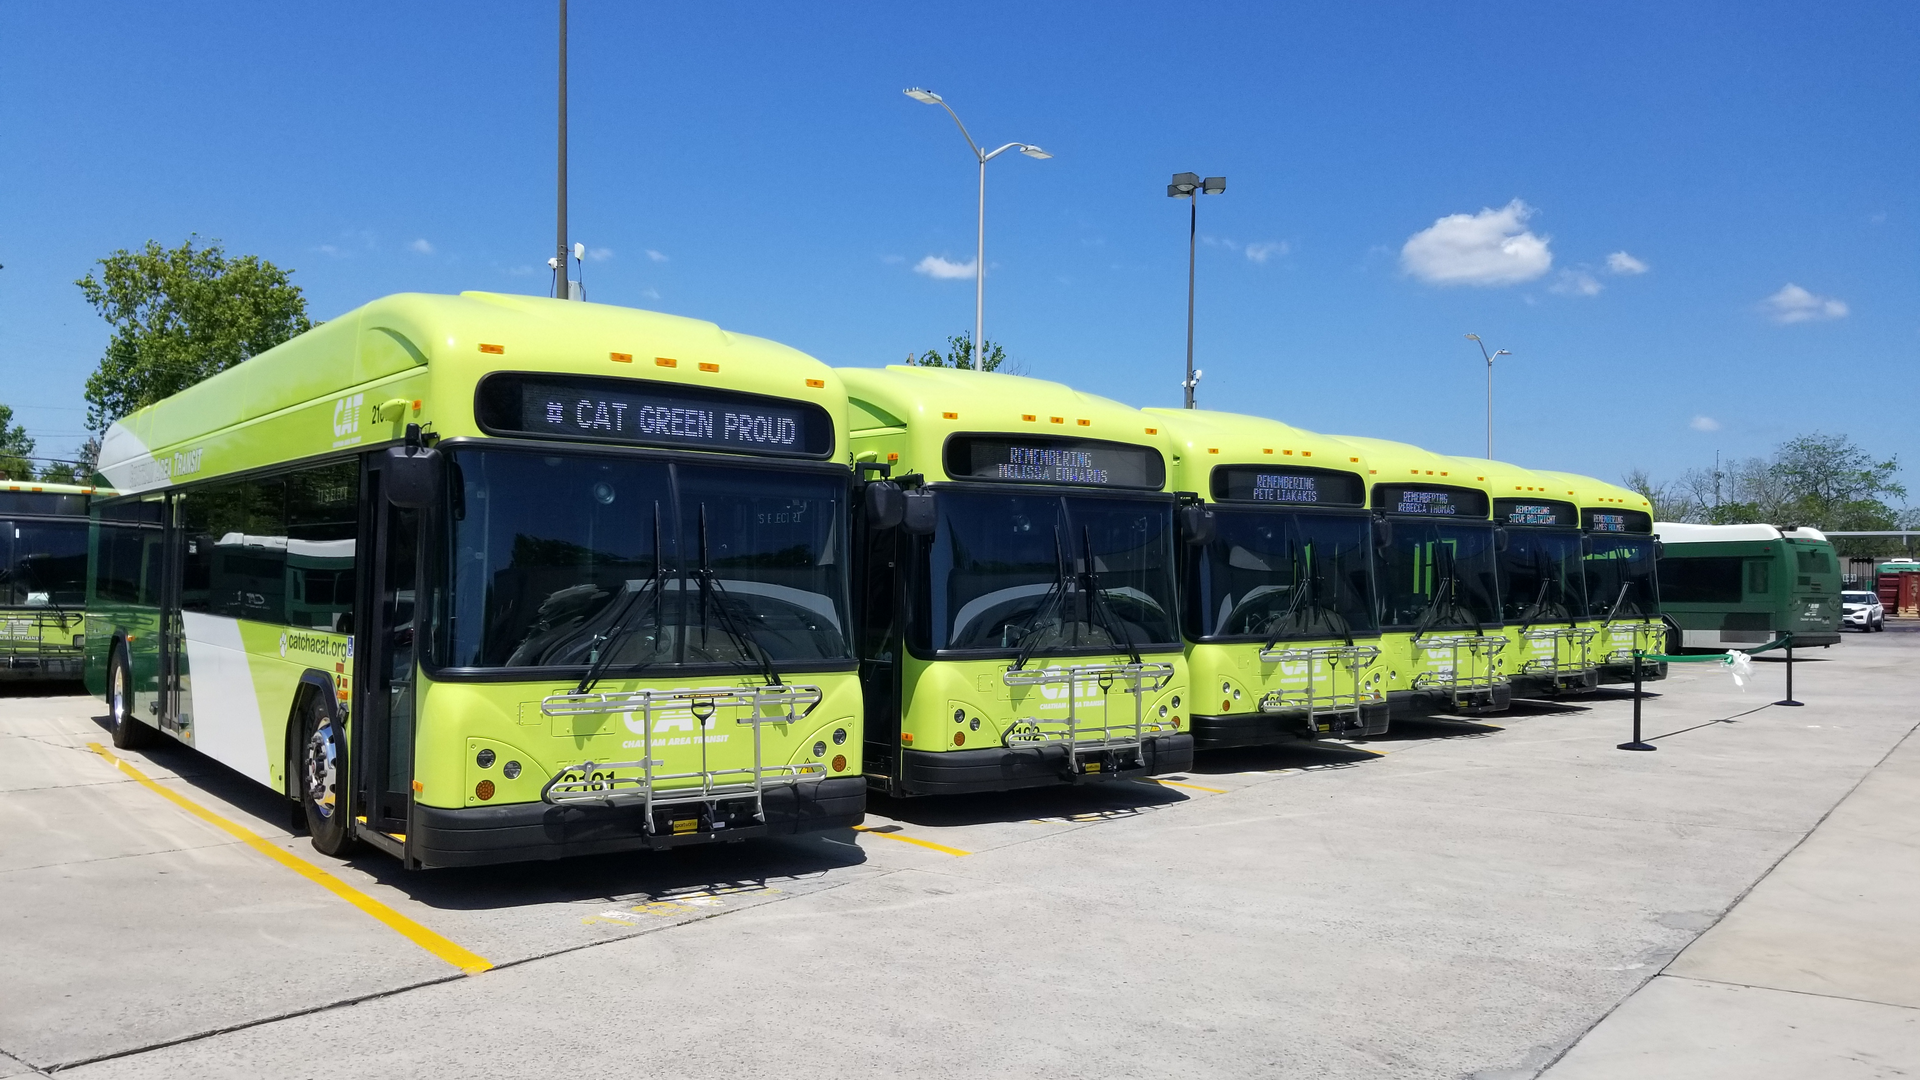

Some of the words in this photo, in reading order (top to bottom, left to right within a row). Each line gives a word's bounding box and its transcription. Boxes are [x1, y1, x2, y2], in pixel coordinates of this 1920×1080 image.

[334, 392, 364, 438] CAT
[546, 401, 563, 424] #
[577, 399, 628, 431] CAT
[640, 405, 713, 438] GREEN
[724, 412, 796, 445] PROUD
[174, 447, 203, 477] TRANSIT
[1010, 447, 1092, 468] REMEMBERING
[998, 463, 1050, 480] MELISSA
[1056, 467, 1108, 483] EDWARDS
[1256, 474, 1315, 490] REMEMBERING
[1253, 488, 1274, 500] PETE
[1277, 489, 1317, 502] LIAKAKIS
[1403, 491, 1448, 504] REMEMBERING
[1398, 502, 1427, 513] REBECCA
[1430, 503, 1456, 515] THOMAS
[1515, 505, 1550, 515] REMEMBERING
[288, 632, 347, 663] catchacat.org
[1040, 663, 1107, 700] CAT
[623, 686, 731, 735] CAT
[622, 738, 666, 749] CHATAM
[668, 736, 691, 747] AREA
[693, 734, 729, 745] TRANSIT
[563, 771, 614, 792] 2101
